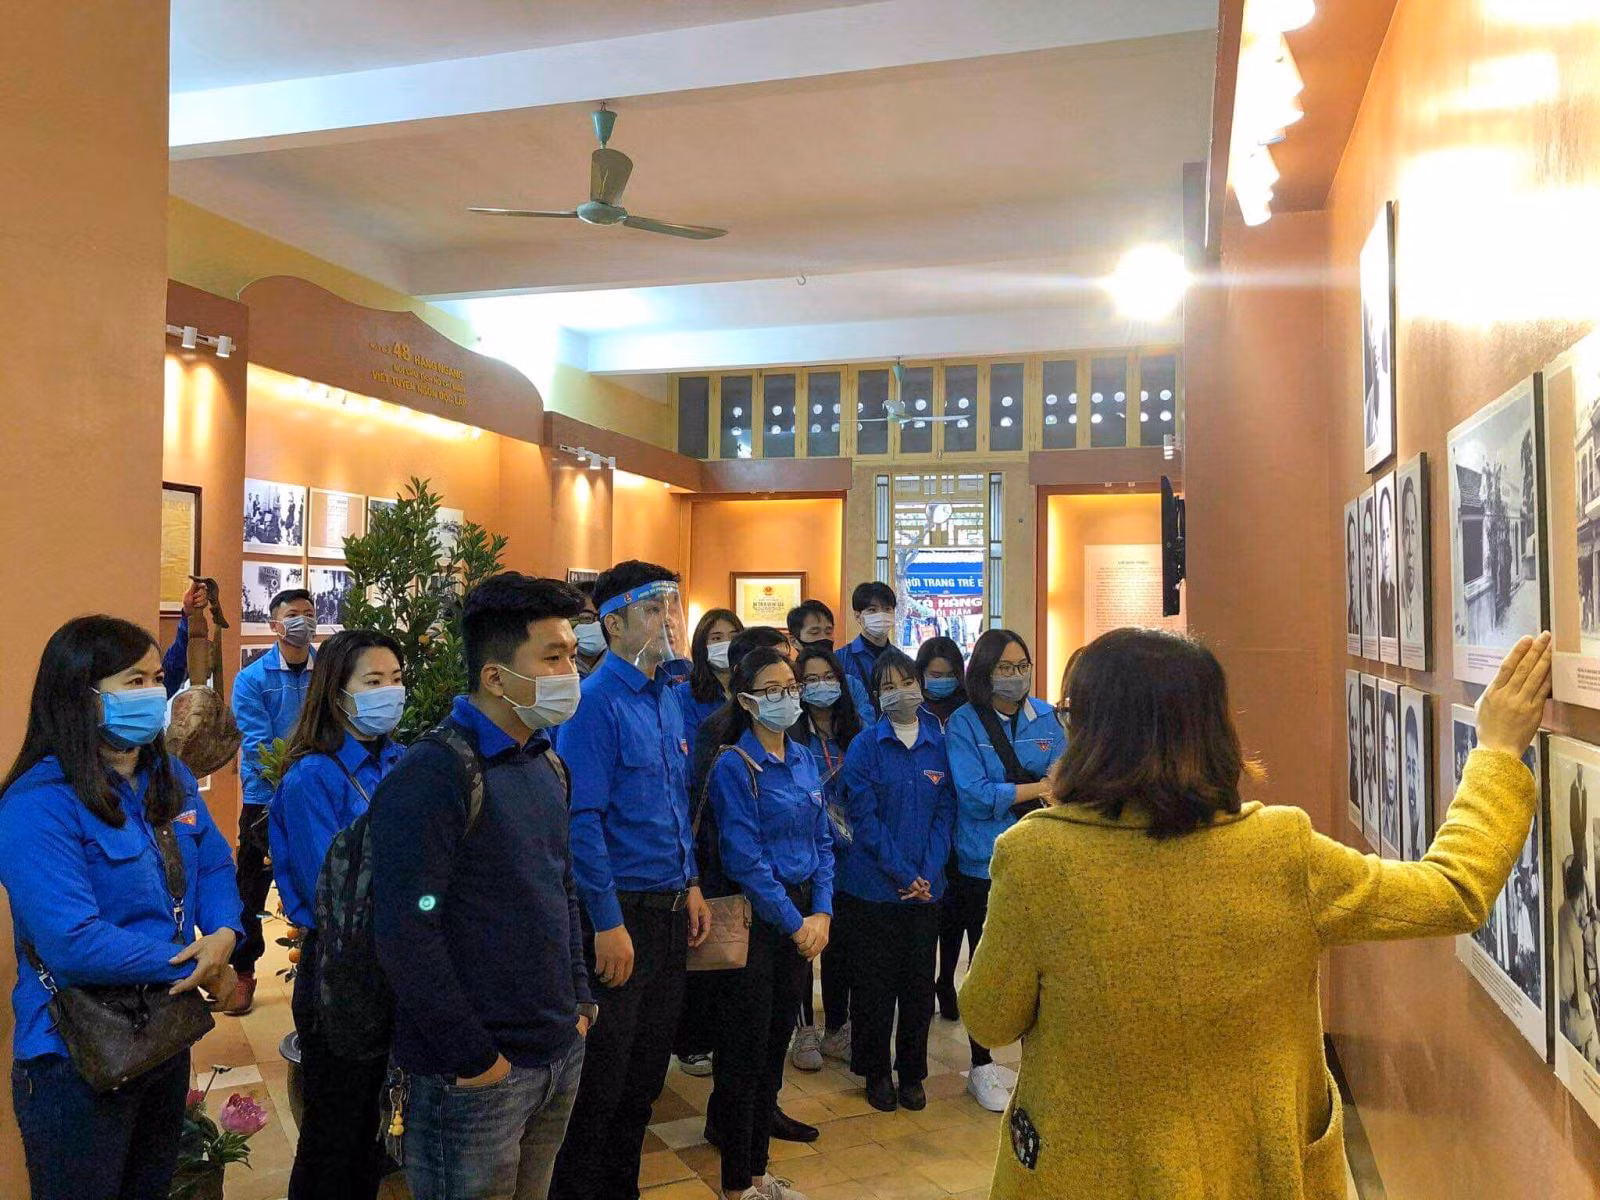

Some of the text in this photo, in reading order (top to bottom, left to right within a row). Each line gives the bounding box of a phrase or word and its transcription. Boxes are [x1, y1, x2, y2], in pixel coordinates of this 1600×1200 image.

[393, 342, 410, 361] 48
[923, 578, 955, 587] TRANG
[957, 576, 975, 587] TRẺ
[938, 596, 982, 608] HÀNG
